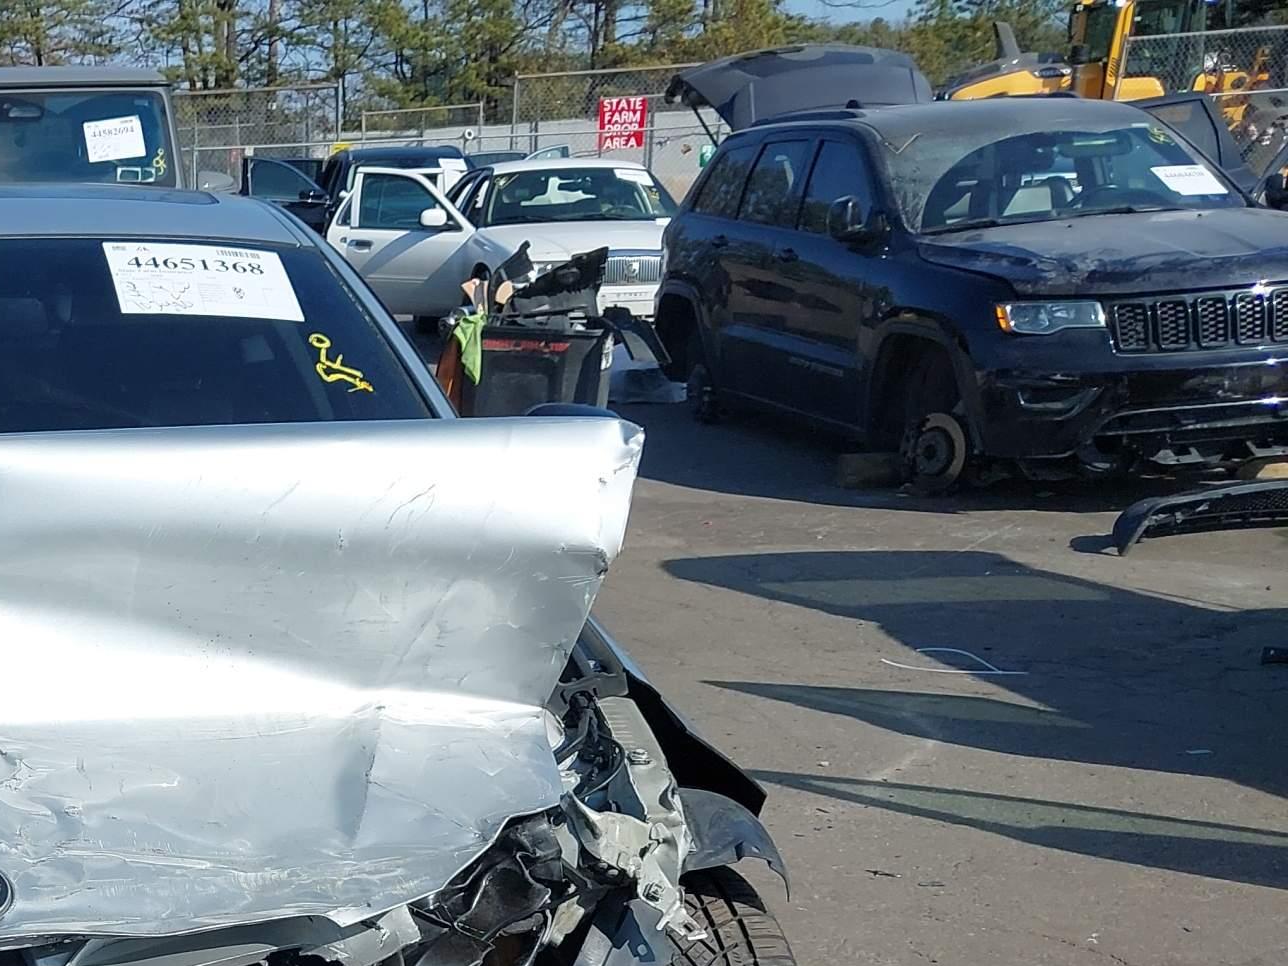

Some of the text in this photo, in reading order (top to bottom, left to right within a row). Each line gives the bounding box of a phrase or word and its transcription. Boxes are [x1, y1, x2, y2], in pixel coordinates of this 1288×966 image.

[603, 98, 643, 111] STATE
[604, 110, 641, 124] FARM
[604, 123, 639, 136] DROP
[602, 136, 637, 150] AREA
[127, 255, 265, 276] 44651368
